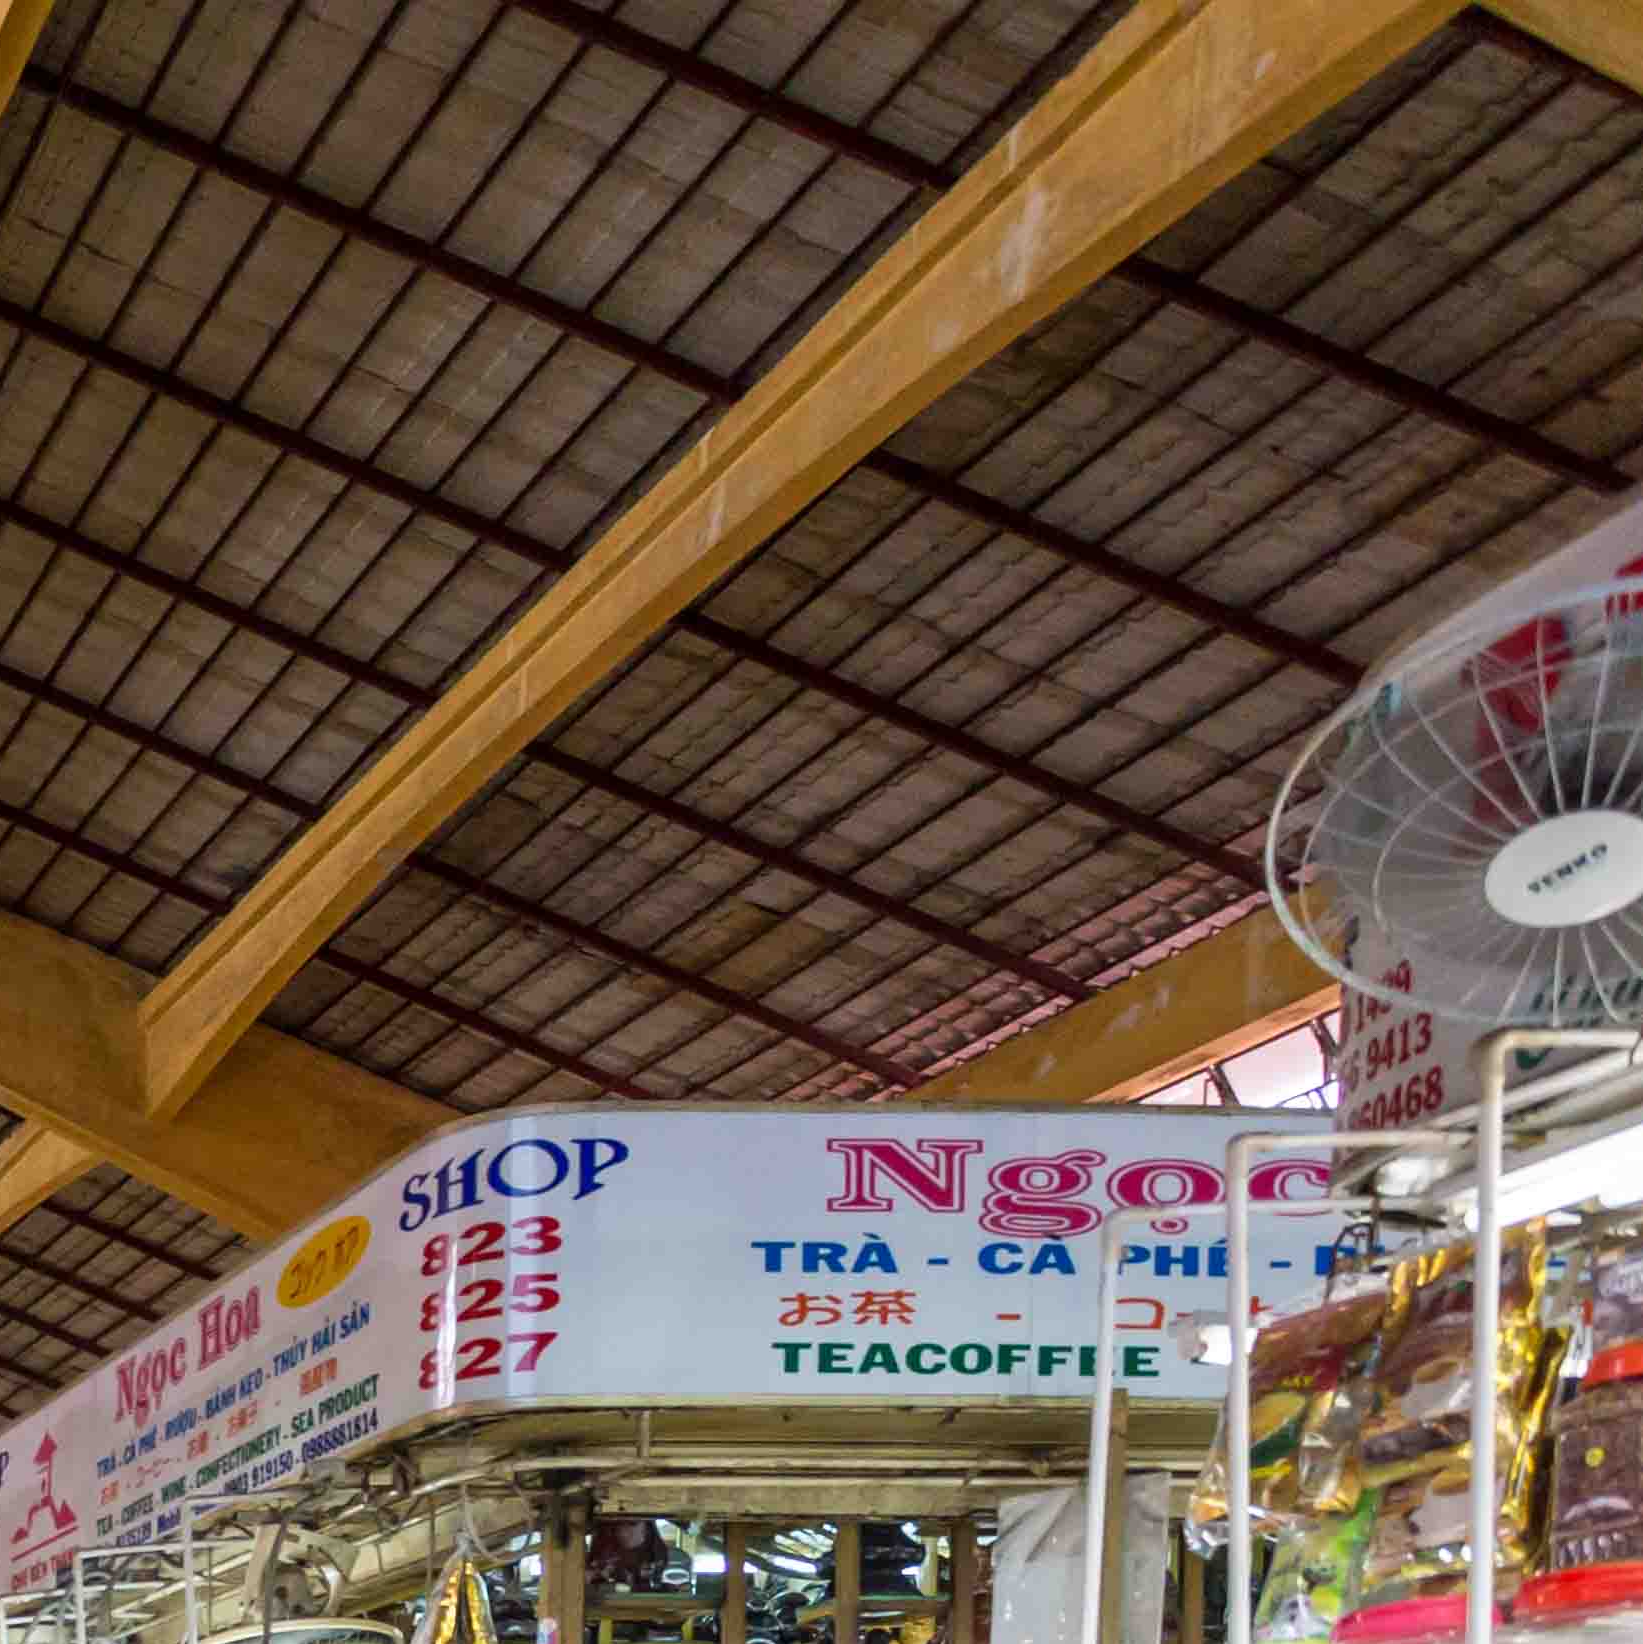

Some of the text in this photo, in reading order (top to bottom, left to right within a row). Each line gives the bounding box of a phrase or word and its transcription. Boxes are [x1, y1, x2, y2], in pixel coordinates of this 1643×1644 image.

[399, 1138, 629, 1232] SHOP
[421, 1216, 562, 1276] 823
[750, 1232, 898, 1274] TRÀ
[977, 1233, 1075, 1275] CÀ
[340, 1301, 371, 1339] SẢN
[419, 1273, 561, 1332] 825
[778, 1289, 917, 1327] お茶
[114, 1337, 186, 1428] Ngọc
[197, 1285, 261, 1371] Hoa
[418, 1332, 559, 1390] 827
[291, 1408, 314, 1438] SEA
[317, 1373, 380, 1424] PRODUCT
